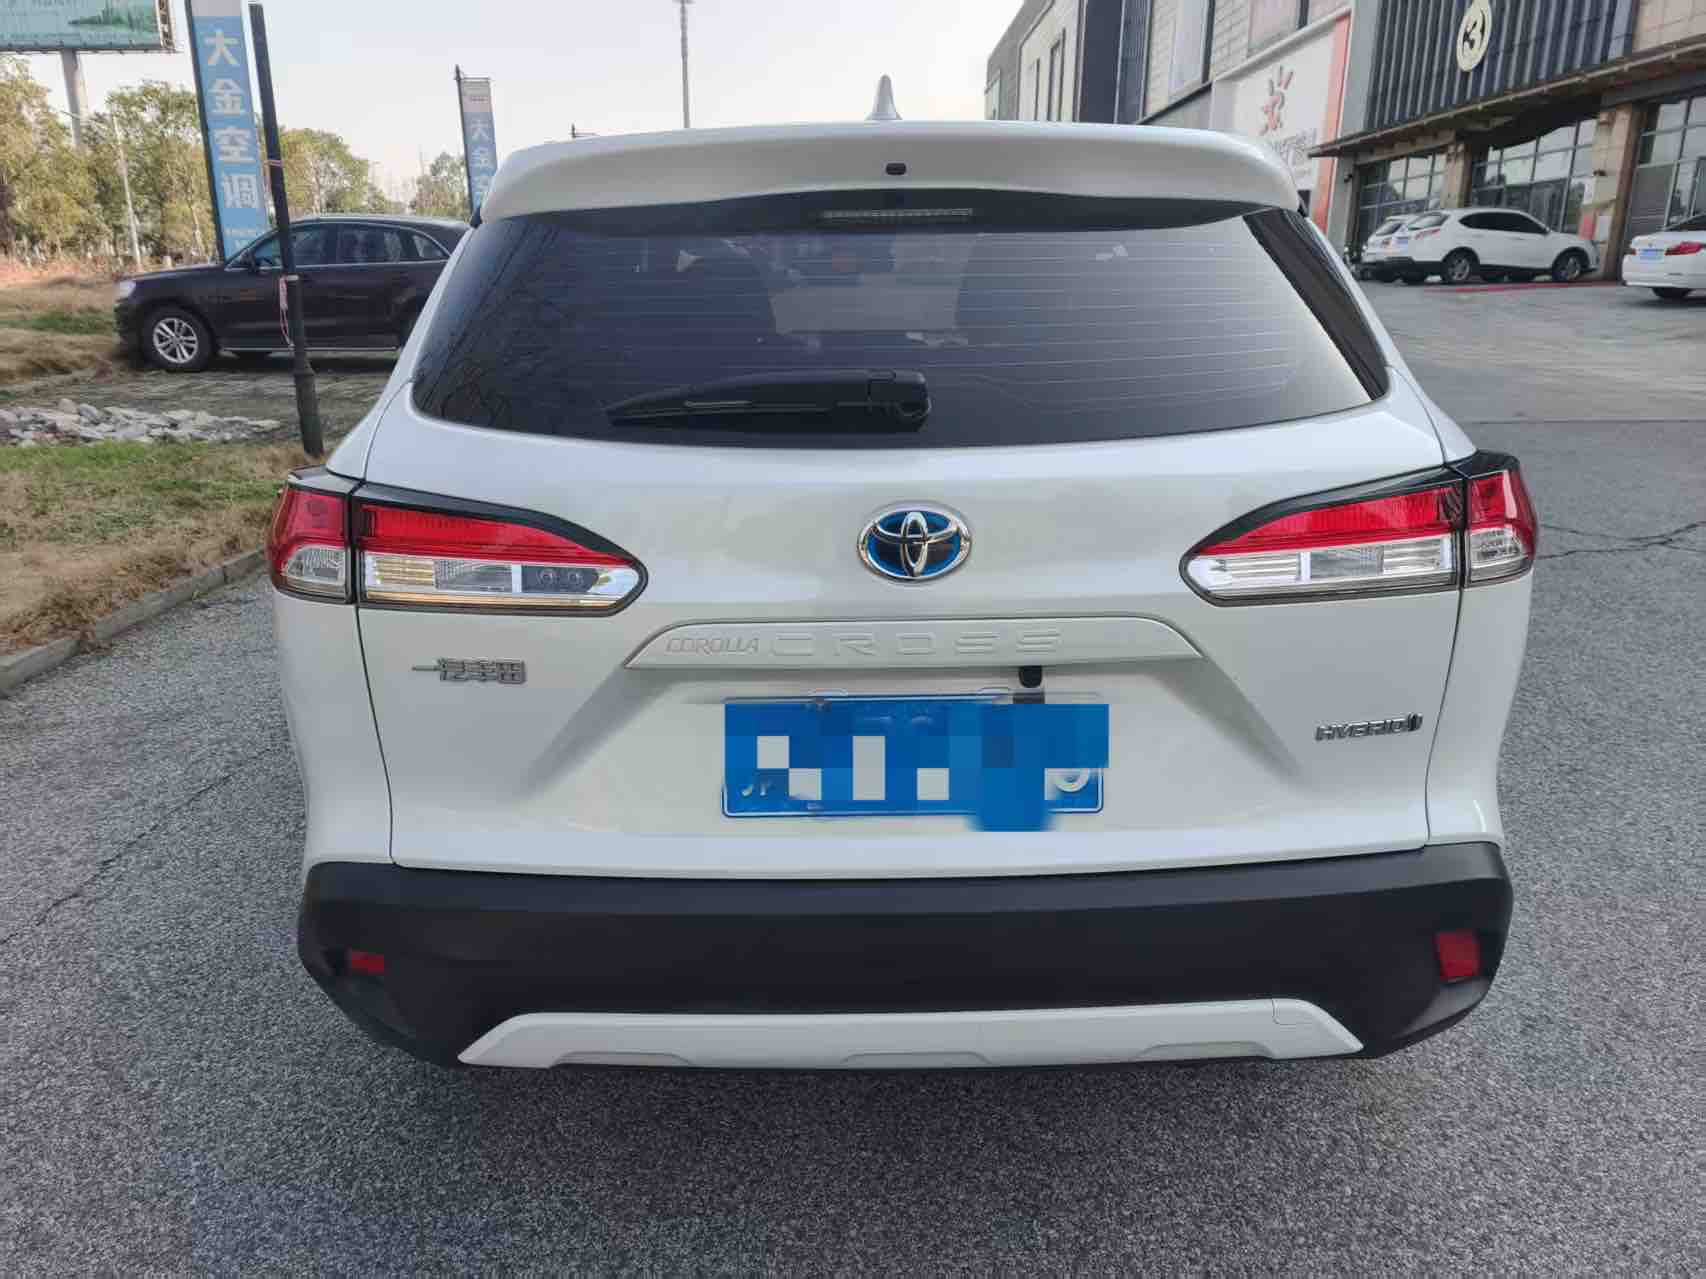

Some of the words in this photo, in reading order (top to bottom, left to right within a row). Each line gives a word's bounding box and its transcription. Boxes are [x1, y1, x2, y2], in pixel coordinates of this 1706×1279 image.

[203, 30, 259, 210] 大金空调
[665, 636, 760, 656] COROLLA
[772, 629, 1063, 657] CROSS
[1314, 717, 1407, 742] HYBRID
